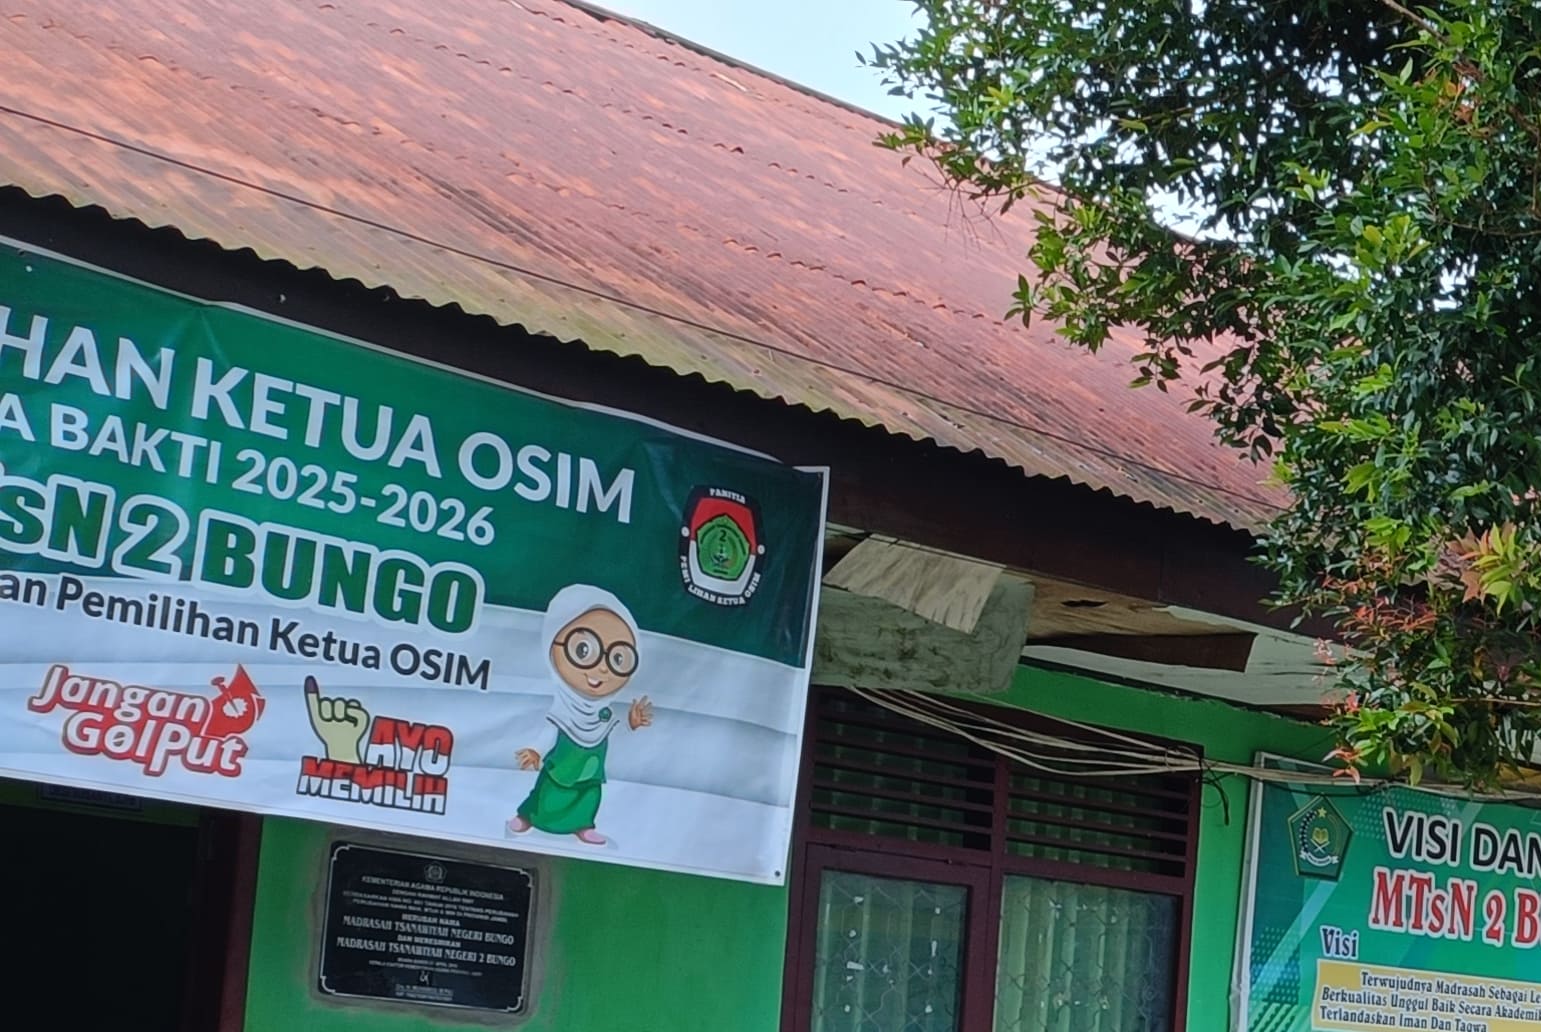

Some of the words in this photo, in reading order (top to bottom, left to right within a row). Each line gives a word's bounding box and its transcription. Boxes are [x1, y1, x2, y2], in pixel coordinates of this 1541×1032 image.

[0, 305, 175, 410] HAN
[191, 356, 442, 479] KETUA
[457, 431, 636, 524] OSIM
[50, 402, 222, 485] BAKTI
[231, 448, 496, 546] 2025-2026
[709, 488, 746, 504] PANITIA
[121, 497, 187, 579] 2
[199, 510, 485, 638] BUNGO
[0, 574, 45, 605] an
[58, 575, 260, 647] Pemilihan
[270, 617, 381, 671] Ketua
[390, 642, 491, 690] OSIM
[32, 664, 208, 723] Jangan
[366, 715, 455, 777] AYO
[297, 755, 448, 815] MEMILIH
[1385, 809, 1460, 863] VISI
[343, 915, 392, 931] MADRASAH
[395, 920, 449, 937] TSANAWIYAH
[451, 928, 482, 941] NEGERI
[484, 932, 514, 945] BUNGO
[1372, 870, 1476, 938] MTsN
[1486, 891, 1503, 945] 2
[336, 936, 386, 952] MADRASAH
[388, 942, 442, 959] TSANAWIYAH
[444, 949, 477, 963] NEGERI
[479, 953, 485, 963] 2
[486, 954, 516, 967] BUNGO
[1320, 926, 1359, 959] Visi
[1322, 987, 1387, 1007] Berkualitas
[1390, 993, 1428, 1012] Unggul
[1431, 998, 1456, 1014] Baik
[1458, 1001, 1492, 1018] Secara
[1361, 971, 1432, 994] Terwujudnya
[1435, 980, 1486, 999] Madrasah
[1488, 985, 1528, 1004] Sebagai
[1320, 1006, 1396, 1027] Terlandaskan
[1399, 1012, 1428, 1030] Iman
[1430, 1016, 1452, 1031] Dan
